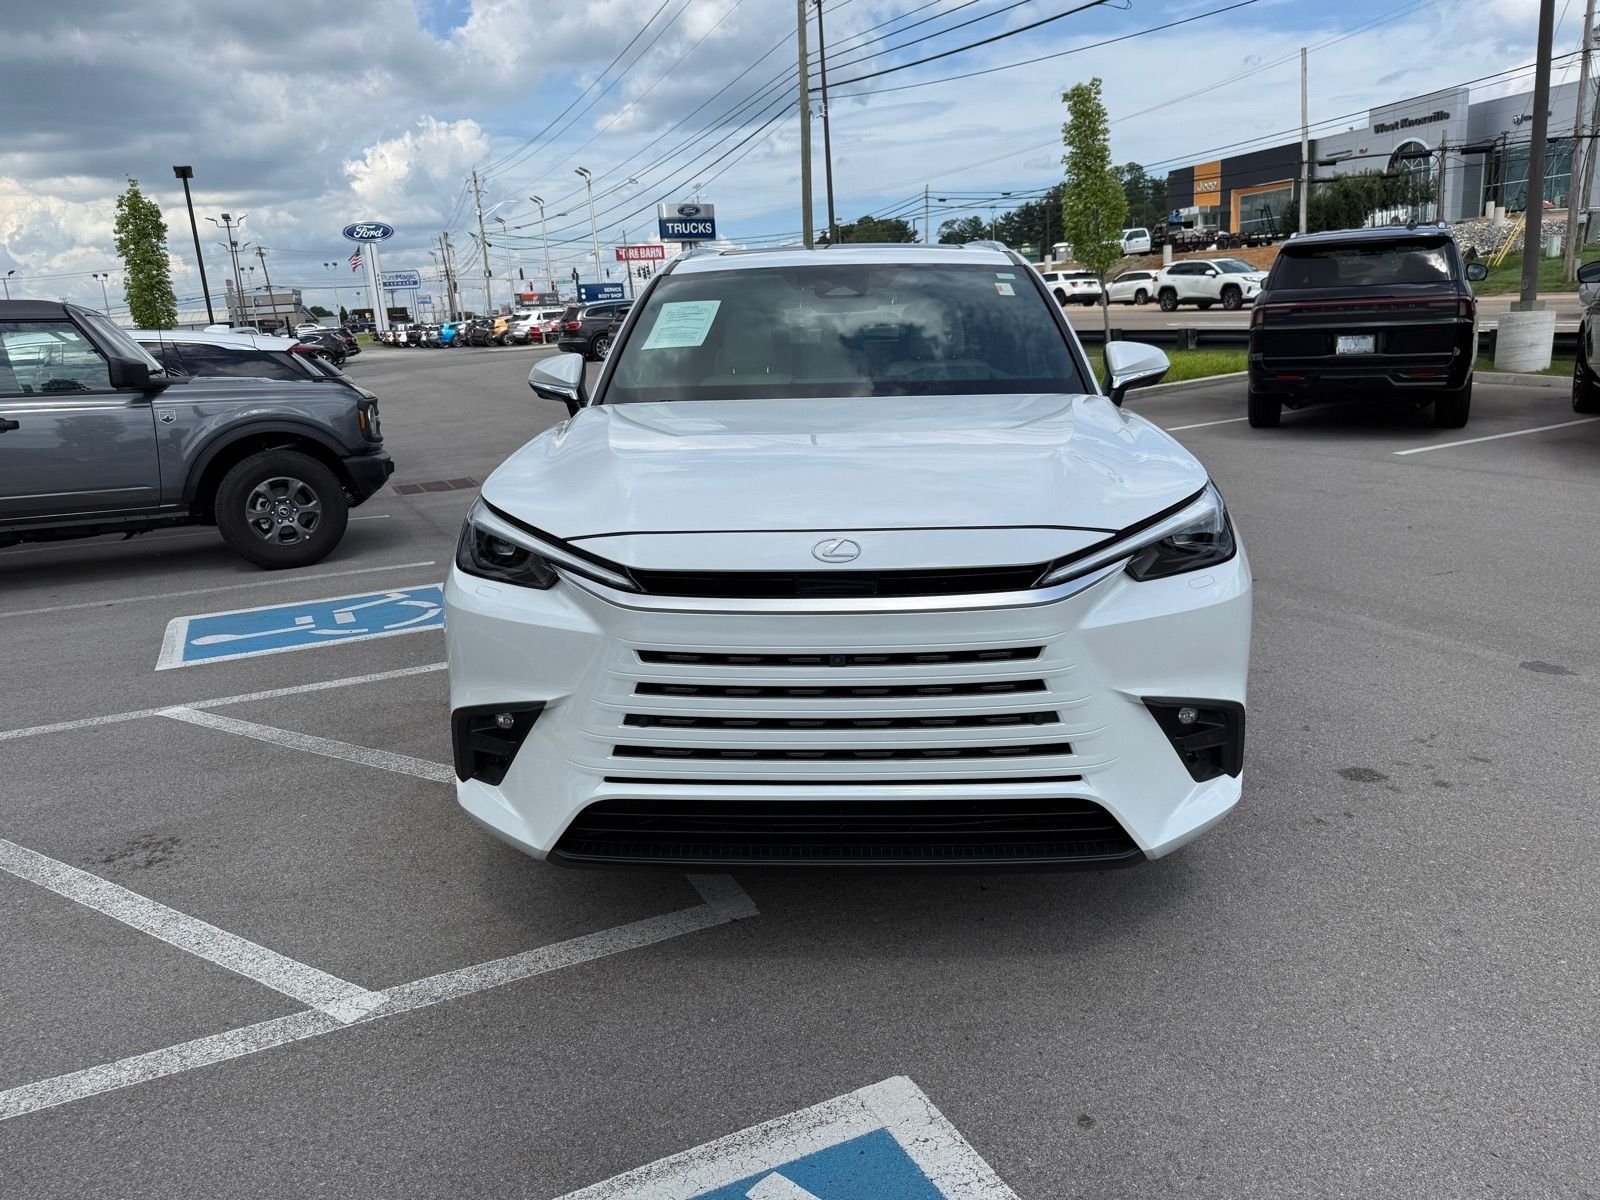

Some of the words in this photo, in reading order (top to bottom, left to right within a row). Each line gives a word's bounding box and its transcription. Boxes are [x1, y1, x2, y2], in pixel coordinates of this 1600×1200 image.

[1374, 121, 1399, 134] West
[1400, 110, 1450, 129] Knoxville
[1197, 181, 1217, 191] Jeep
[353, 225, 384, 238] Ford
[666, 222, 712, 234] TRUCKS
[618, 248, 639, 259] TRE
[640, 247, 662, 259] BARN
